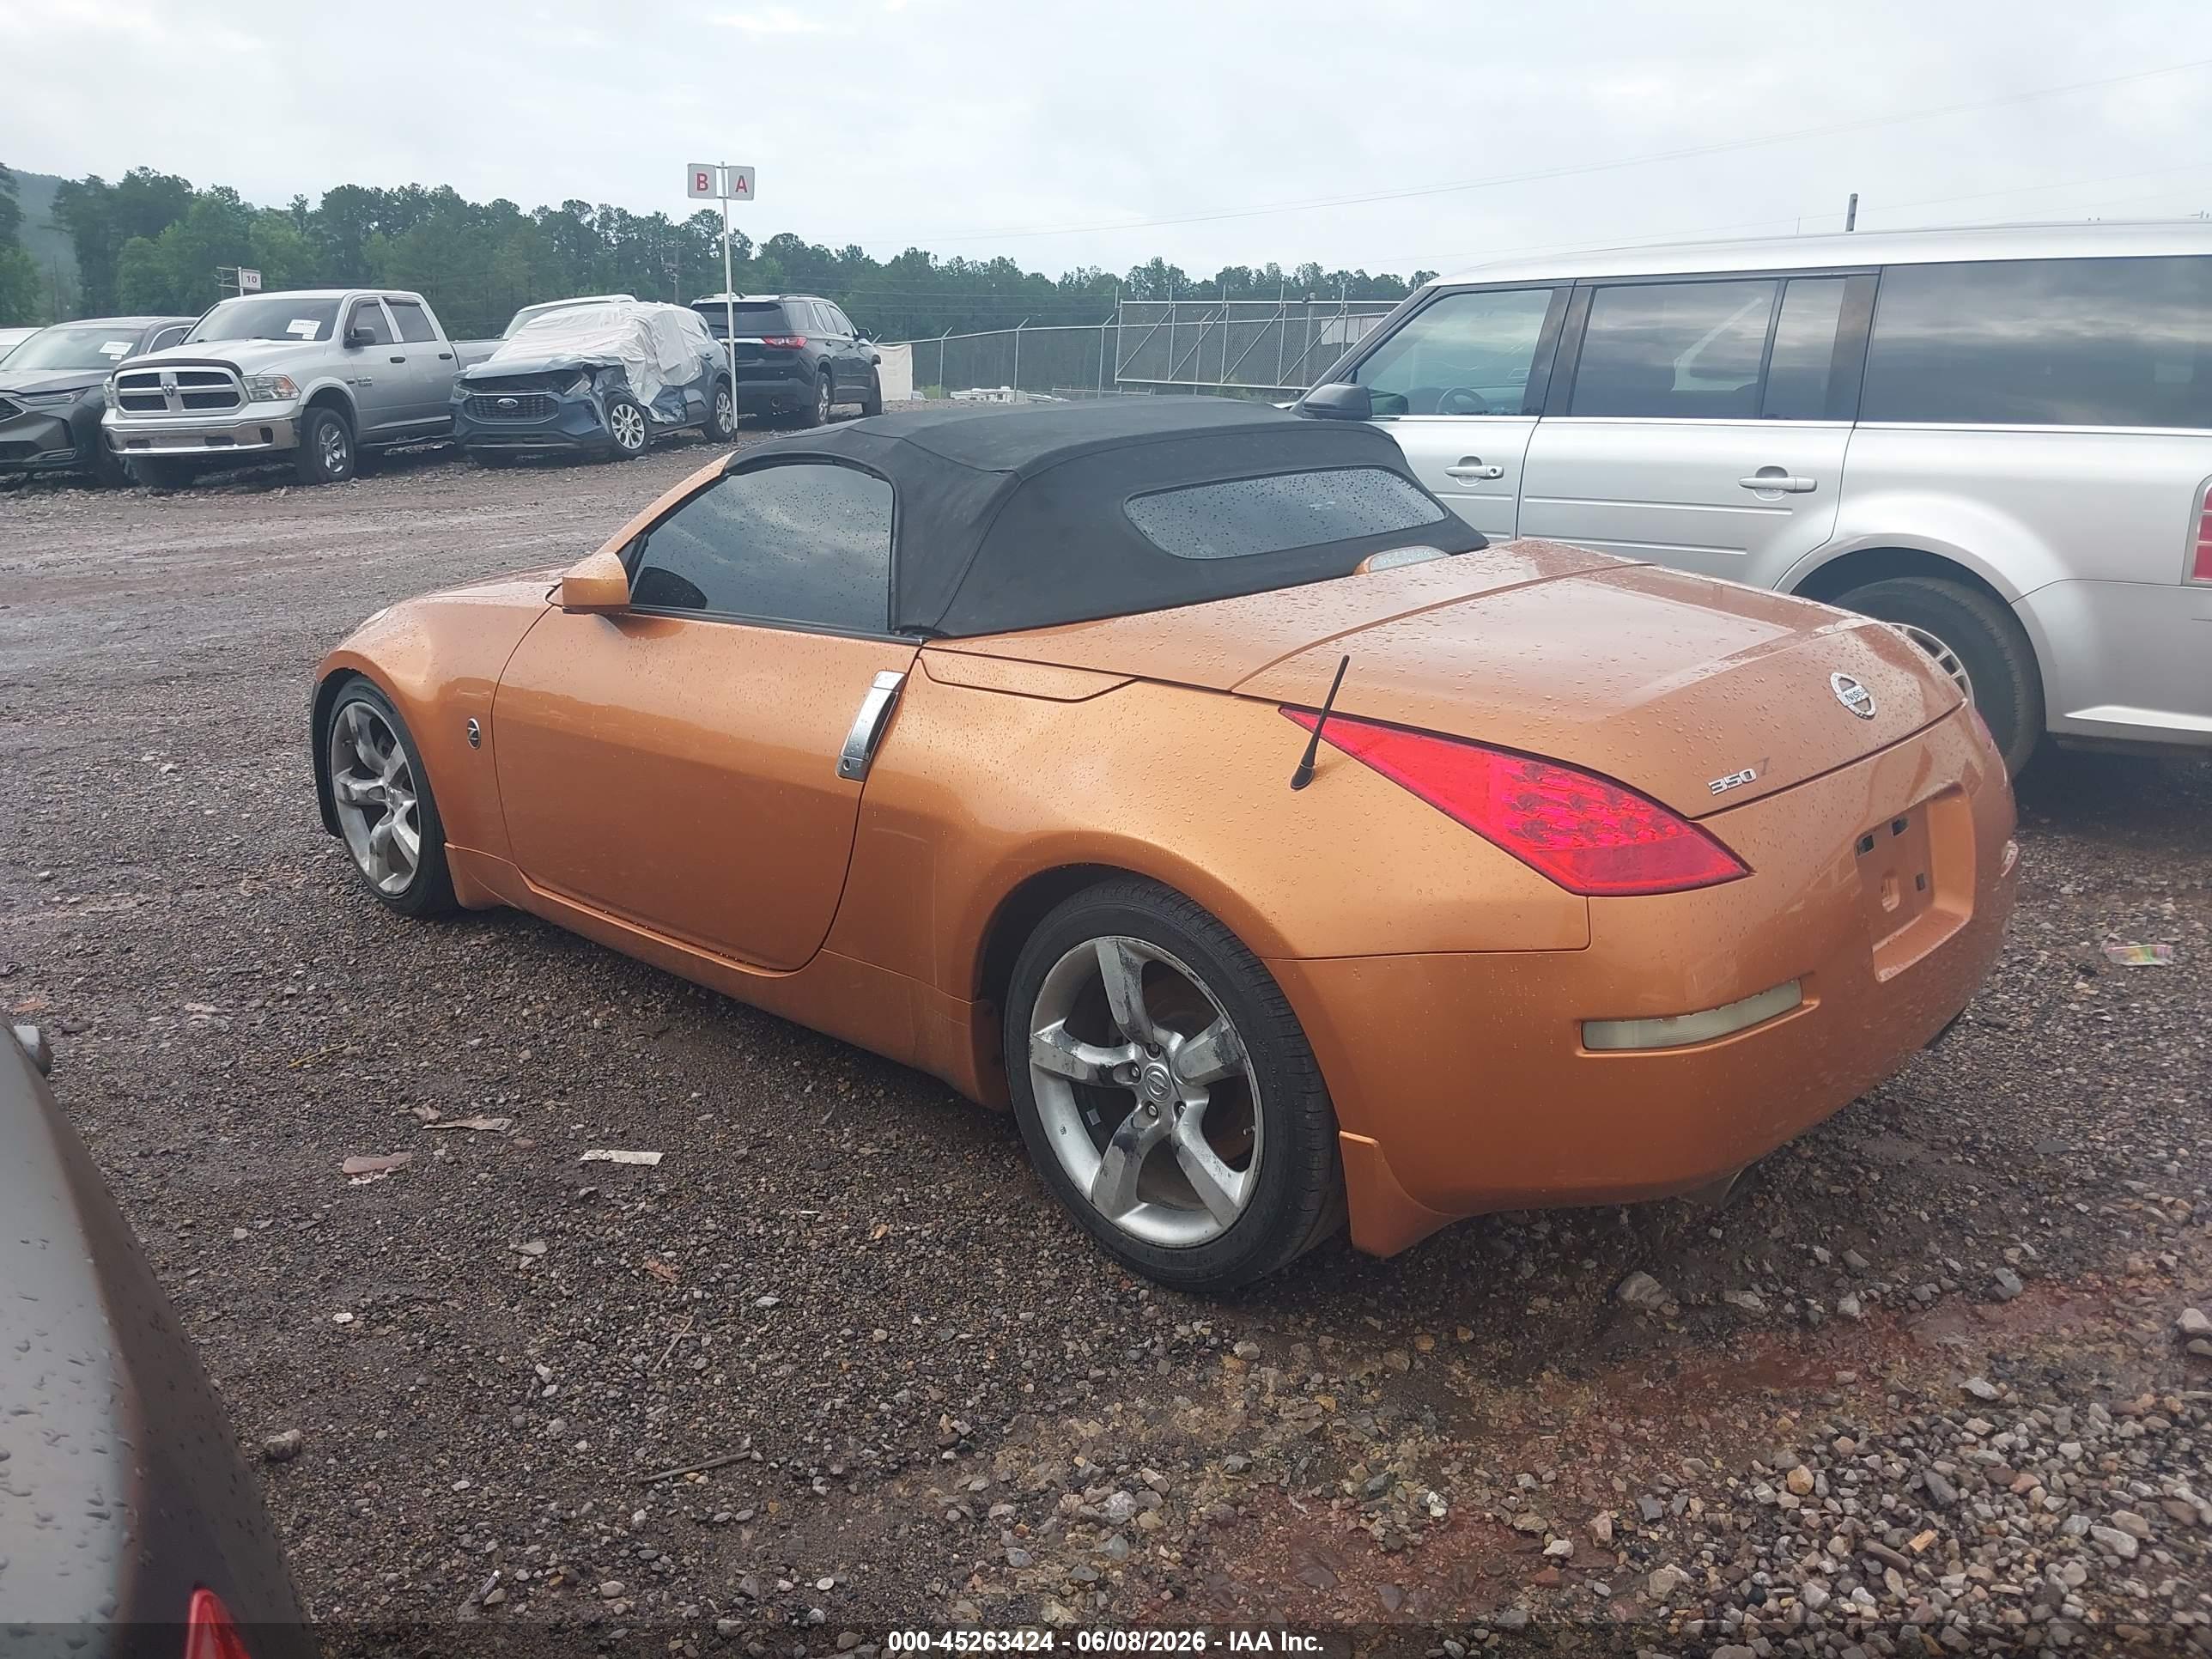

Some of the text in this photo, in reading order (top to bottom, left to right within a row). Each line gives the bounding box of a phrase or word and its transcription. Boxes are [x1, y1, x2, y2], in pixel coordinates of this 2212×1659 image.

[696, 173, 708, 191] B
[735, 174, 748, 193] A
[246, 275, 258, 283] 10
